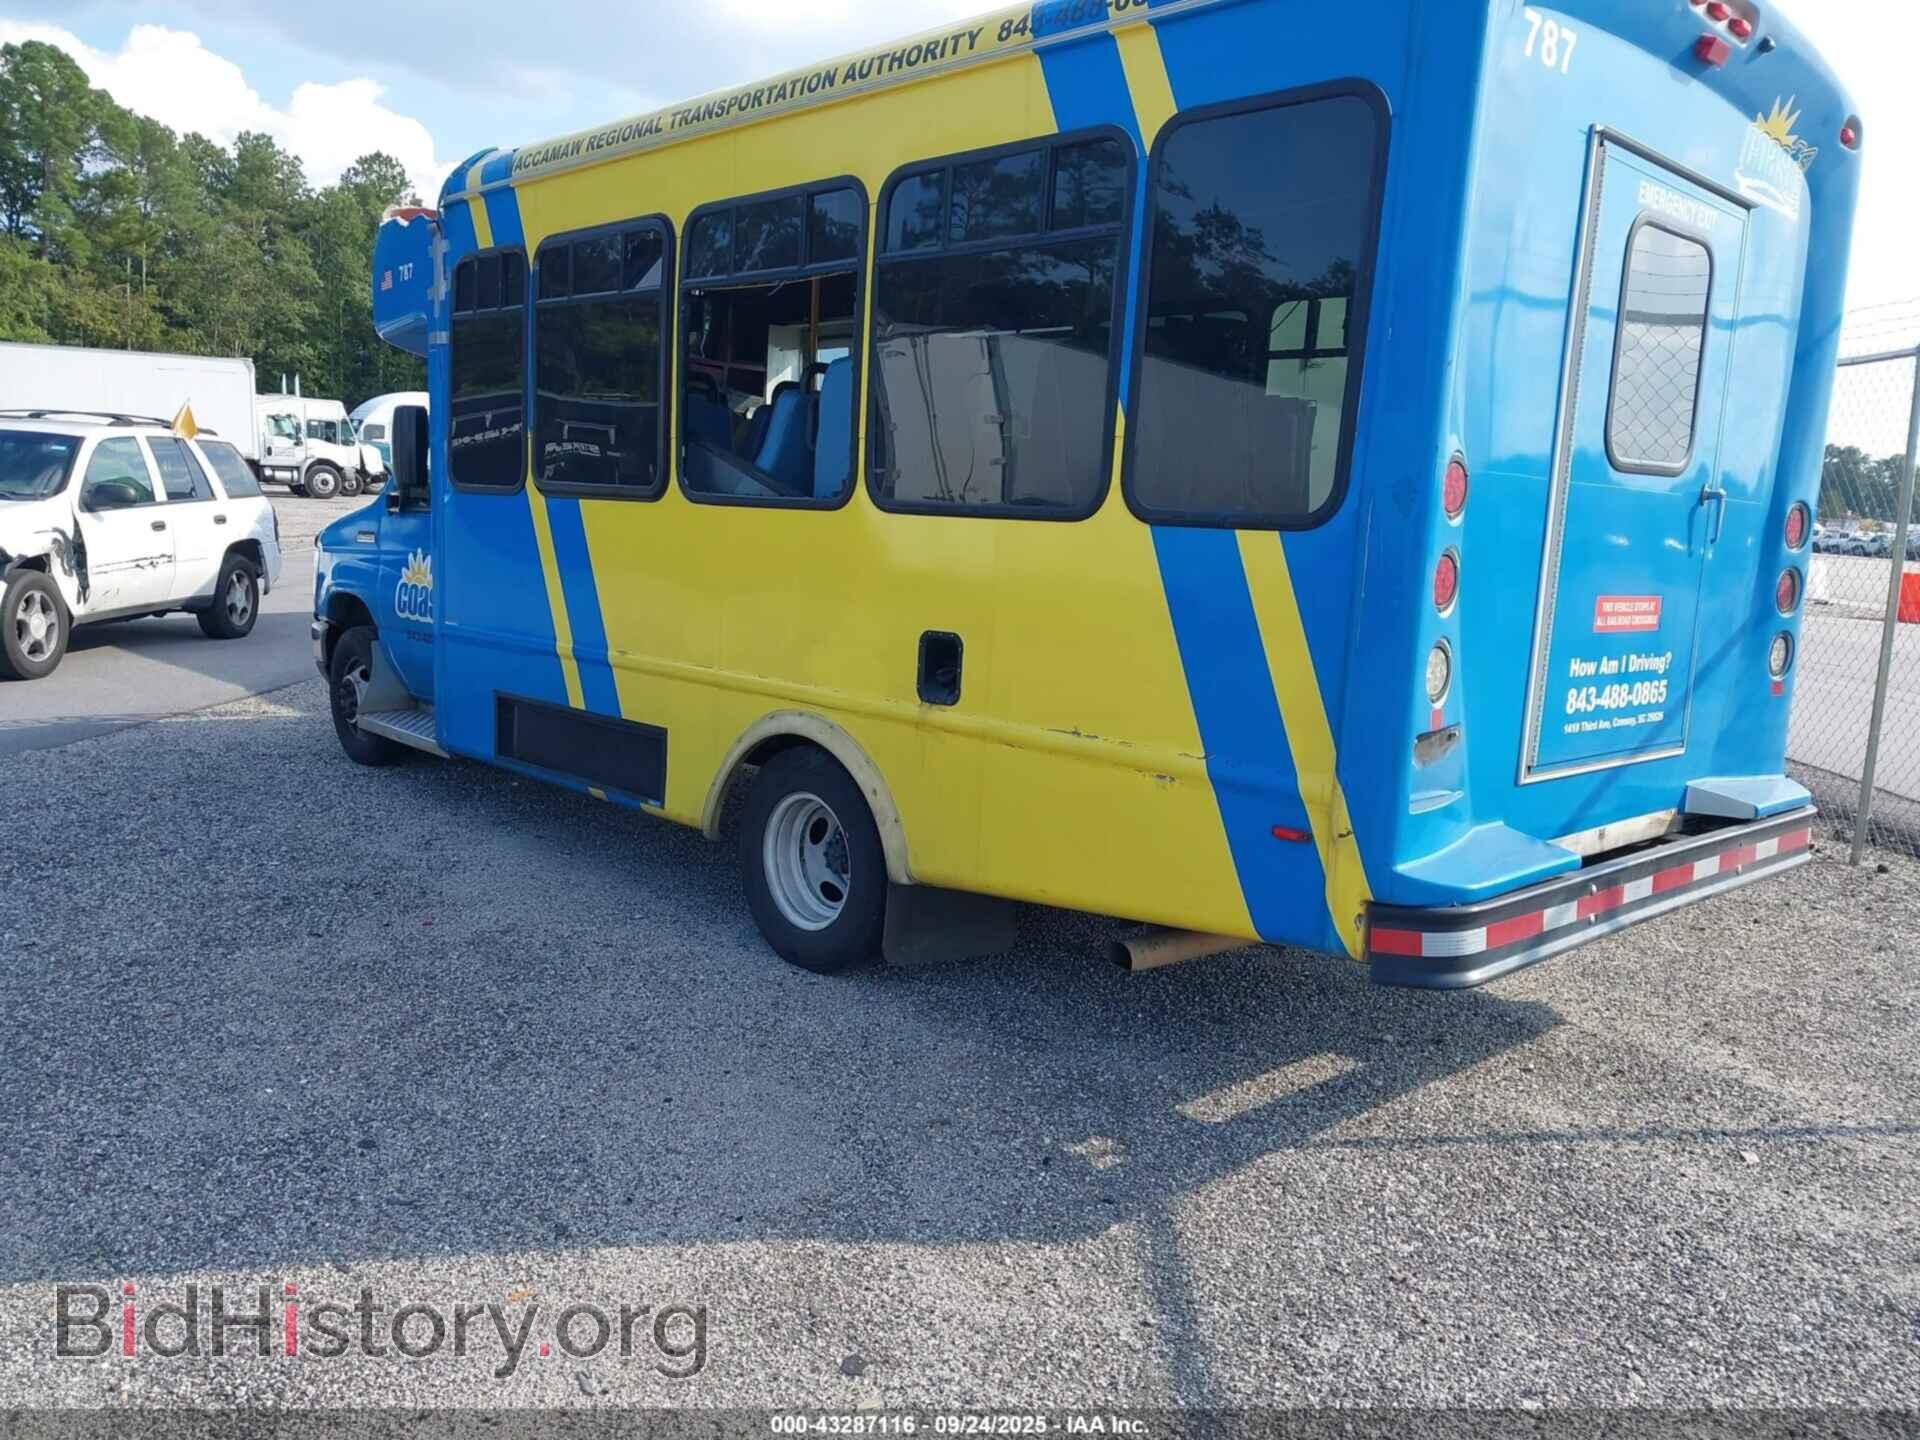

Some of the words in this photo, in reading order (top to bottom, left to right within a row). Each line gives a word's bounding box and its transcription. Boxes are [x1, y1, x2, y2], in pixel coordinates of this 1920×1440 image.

[1523, 6, 1578, 75] 787
[512, 138, 585, 173] ACCAMAW
[585, 116, 664, 153] REGIONAL
[669, 66, 838, 130] TRANSPORTATION
[842, 27, 984, 85] AUTHORITY
[398, 261, 415, 282] 787
[1569, 657, 1597, 678] How
[1599, 655, 1619, 675] Am
[1621, 655, 1627, 673] I
[1628, 651, 1673, 675] Driving?
[1565, 679, 1669, 715] 843-488-0865
